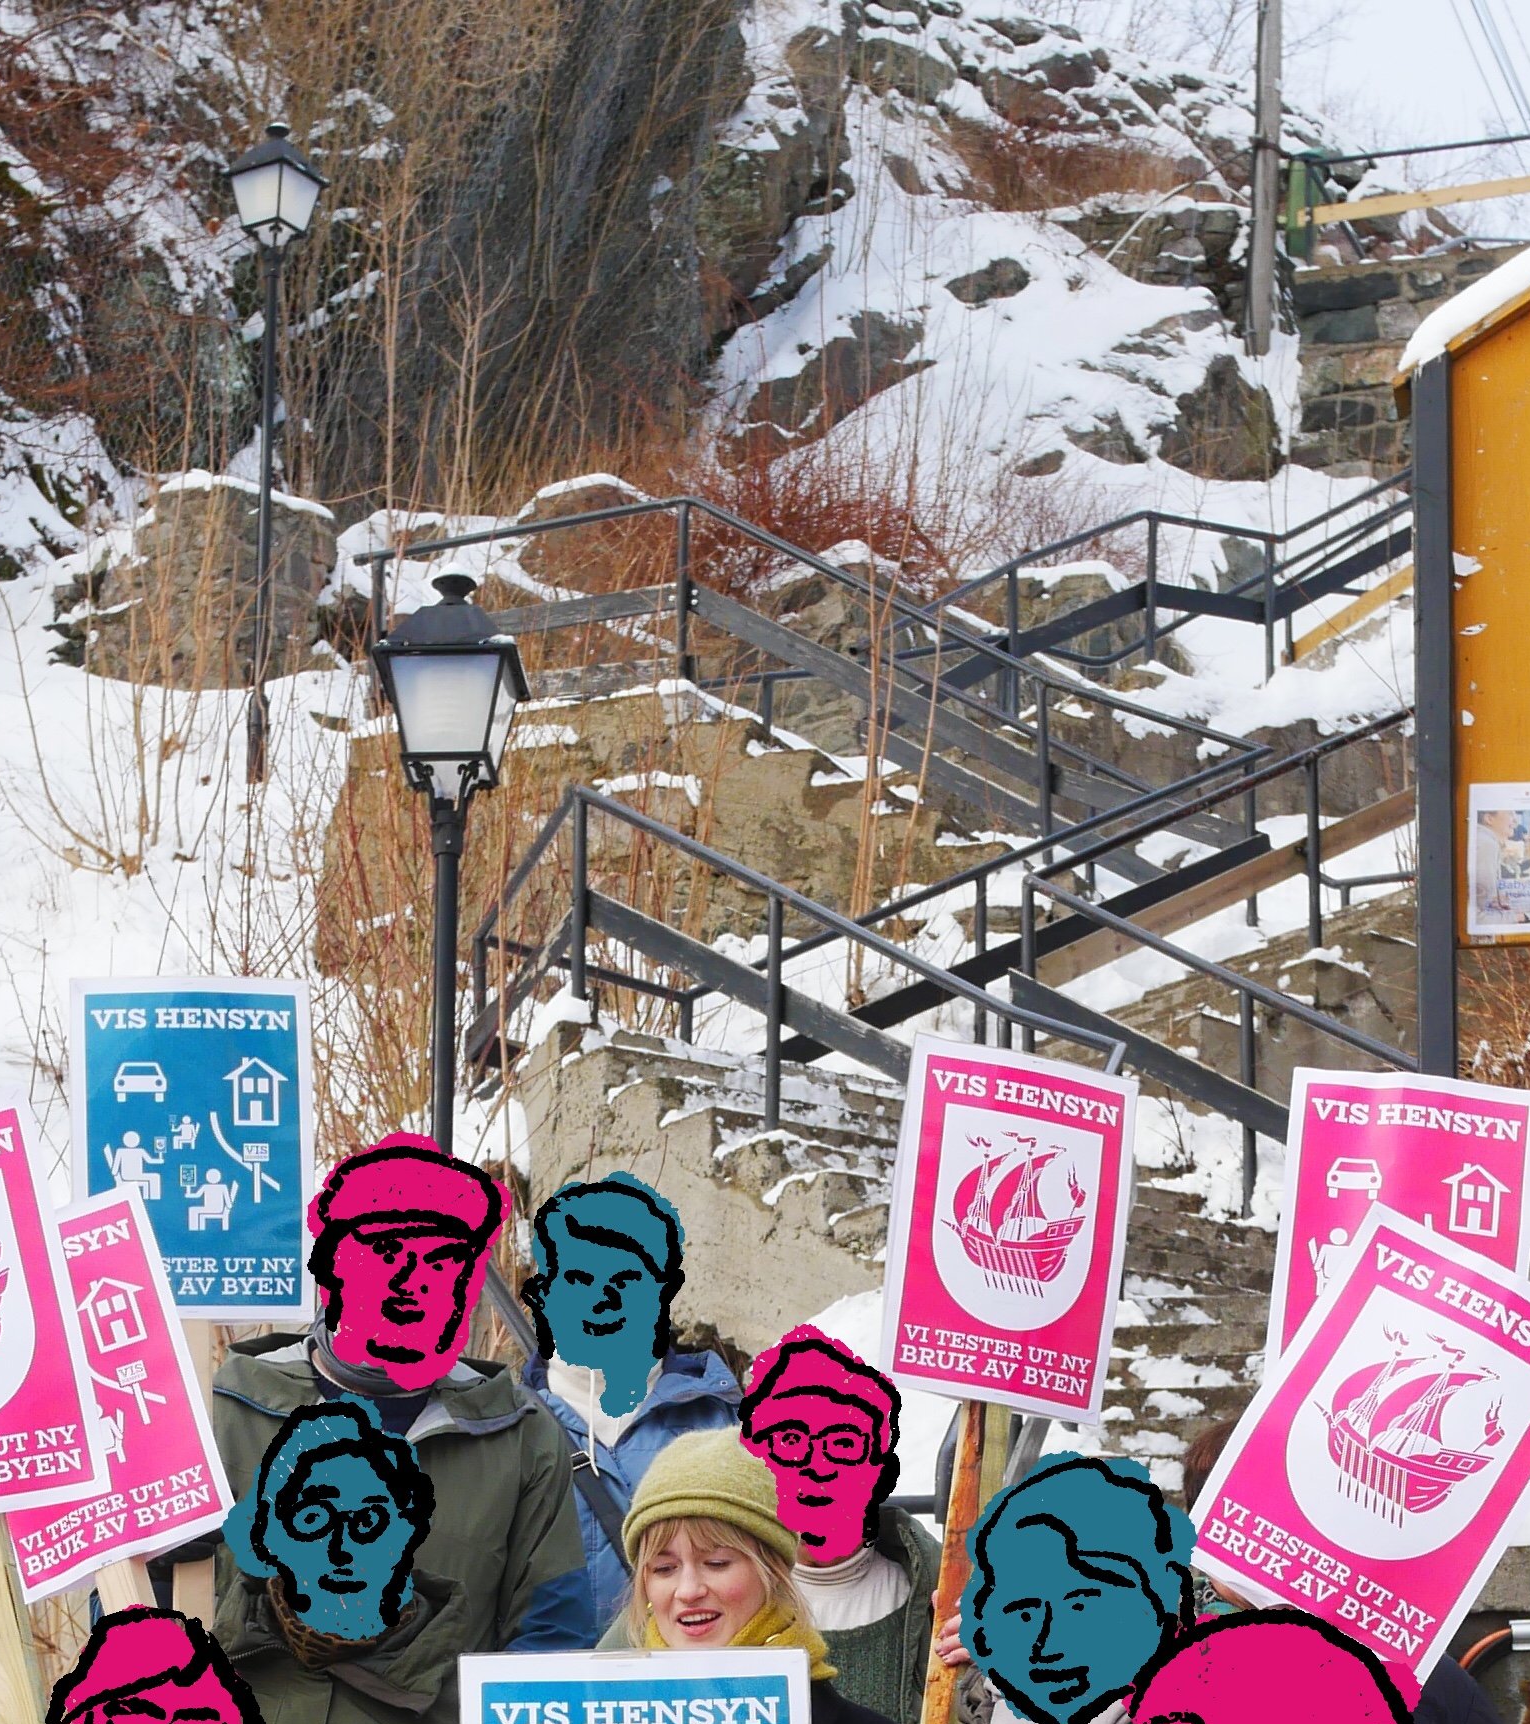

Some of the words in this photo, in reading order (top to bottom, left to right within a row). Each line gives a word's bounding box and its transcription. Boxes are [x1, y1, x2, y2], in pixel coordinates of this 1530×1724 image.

[90, 1008, 147, 1029] VIS
[155, 1008, 291, 1030] HENSYN
[932, 1069, 987, 1097] VIS
[995, 1079, 1119, 1126] HENSYN
[1311, 1097, 1372, 1125] VIS
[1375, 1099, 1523, 1142] HENSYN
[63, 1218, 130, 1260] SYN
[178, 1277, 215, 1295] AV
[222, 1277, 295, 1295] BYEN
[224, 1258, 255, 1273] UT
[262, 1258, 294, 1273] NY
[1376, 1243, 1437, 1292] VIS
[900, 1344, 976, 1373] BRUK
[982, 1359, 1018, 1379] AV
[1023, 1366, 1087, 1396] BYEN
[904, 1324, 929, 1342] VI
[935, 1329, 1022, 1359] TESTER
[1029, 1347, 1057, 1366] UT
[1061, 1354, 1091, 1373] NY
[35, 1424, 77, 1448] NY
[19, 1531, 45, 1552] VI
[46, 1494, 128, 1540] TESTER
[129, 1480, 165, 1503] UT
[169, 1464, 203, 1492] NY
[24, 1529, 89, 1576] BRUK
[93, 1513, 127, 1543] AV
[133, 1484, 210, 1527] BYEN
[1205, 1519, 1291, 1580] BRUK
[1290, 1571, 1338, 1602] AV
[1337, 1595, 1423, 1656] BYEN
[1223, 1497, 1250, 1527] VI
[1253, 1515, 1353, 1586] TESTER
[1356, 1575, 1393, 1607] UT
[1392, 1599, 1435, 1632] NY
